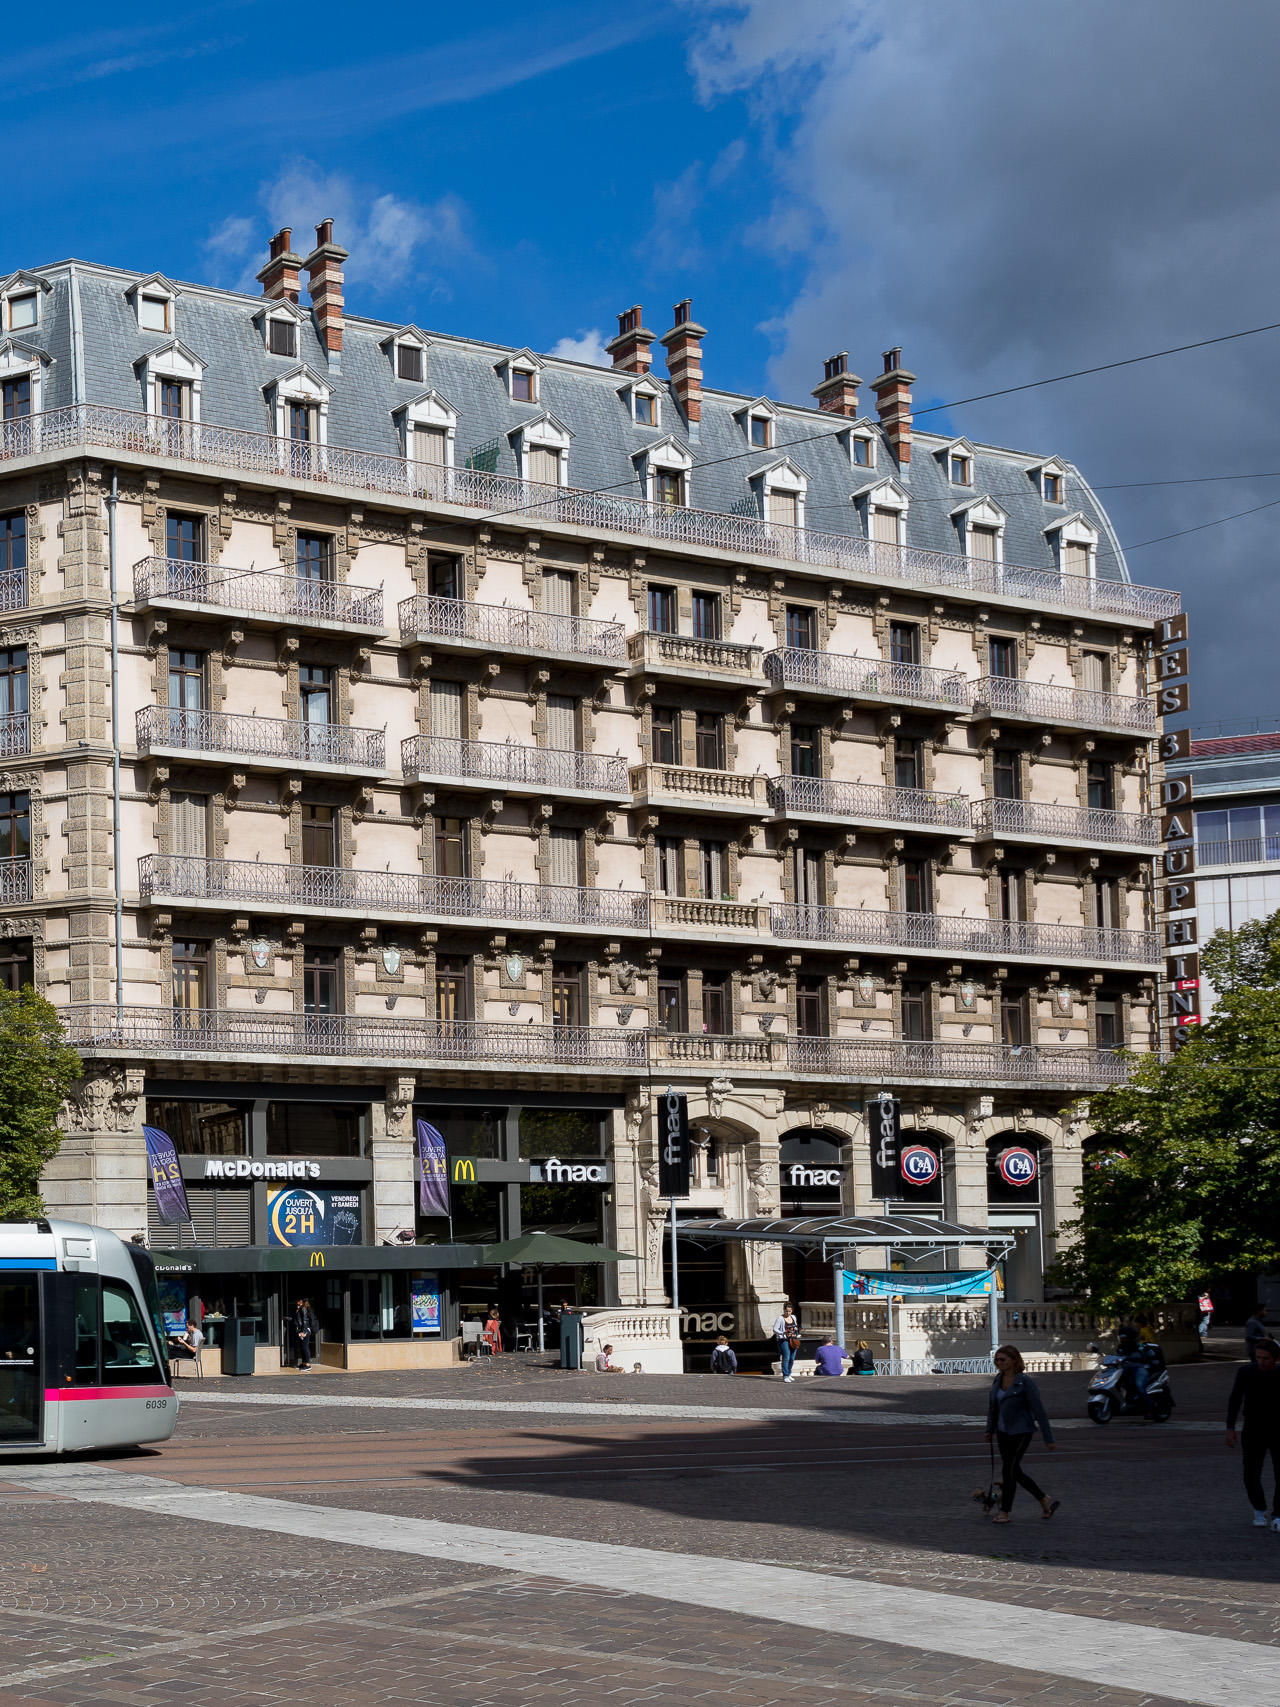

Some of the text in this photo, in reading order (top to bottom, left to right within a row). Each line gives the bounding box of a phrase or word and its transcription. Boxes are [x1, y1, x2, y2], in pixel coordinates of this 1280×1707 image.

[1161, 619, 1183, 714] LES
[1162, 734, 1180, 758] 3
[1161, 780, 1196, 1051] DAUPHINS
[663, 1094, 681, 1166] fnac
[876, 1101, 897, 1169] fnac
[204, 1159, 321, 1178] McDonald's
[545, 1157, 602, 1182] fnac
[790, 1164, 842, 1186] fnac
[909, 1156, 933, 1174] C&A
[1008, 1157, 1032, 1175] C&A
[285, 1199, 313, 1207] OUVERT
[284, 1214, 315, 1233] 2 H
[145, 1399, 168, 1410] 6039
